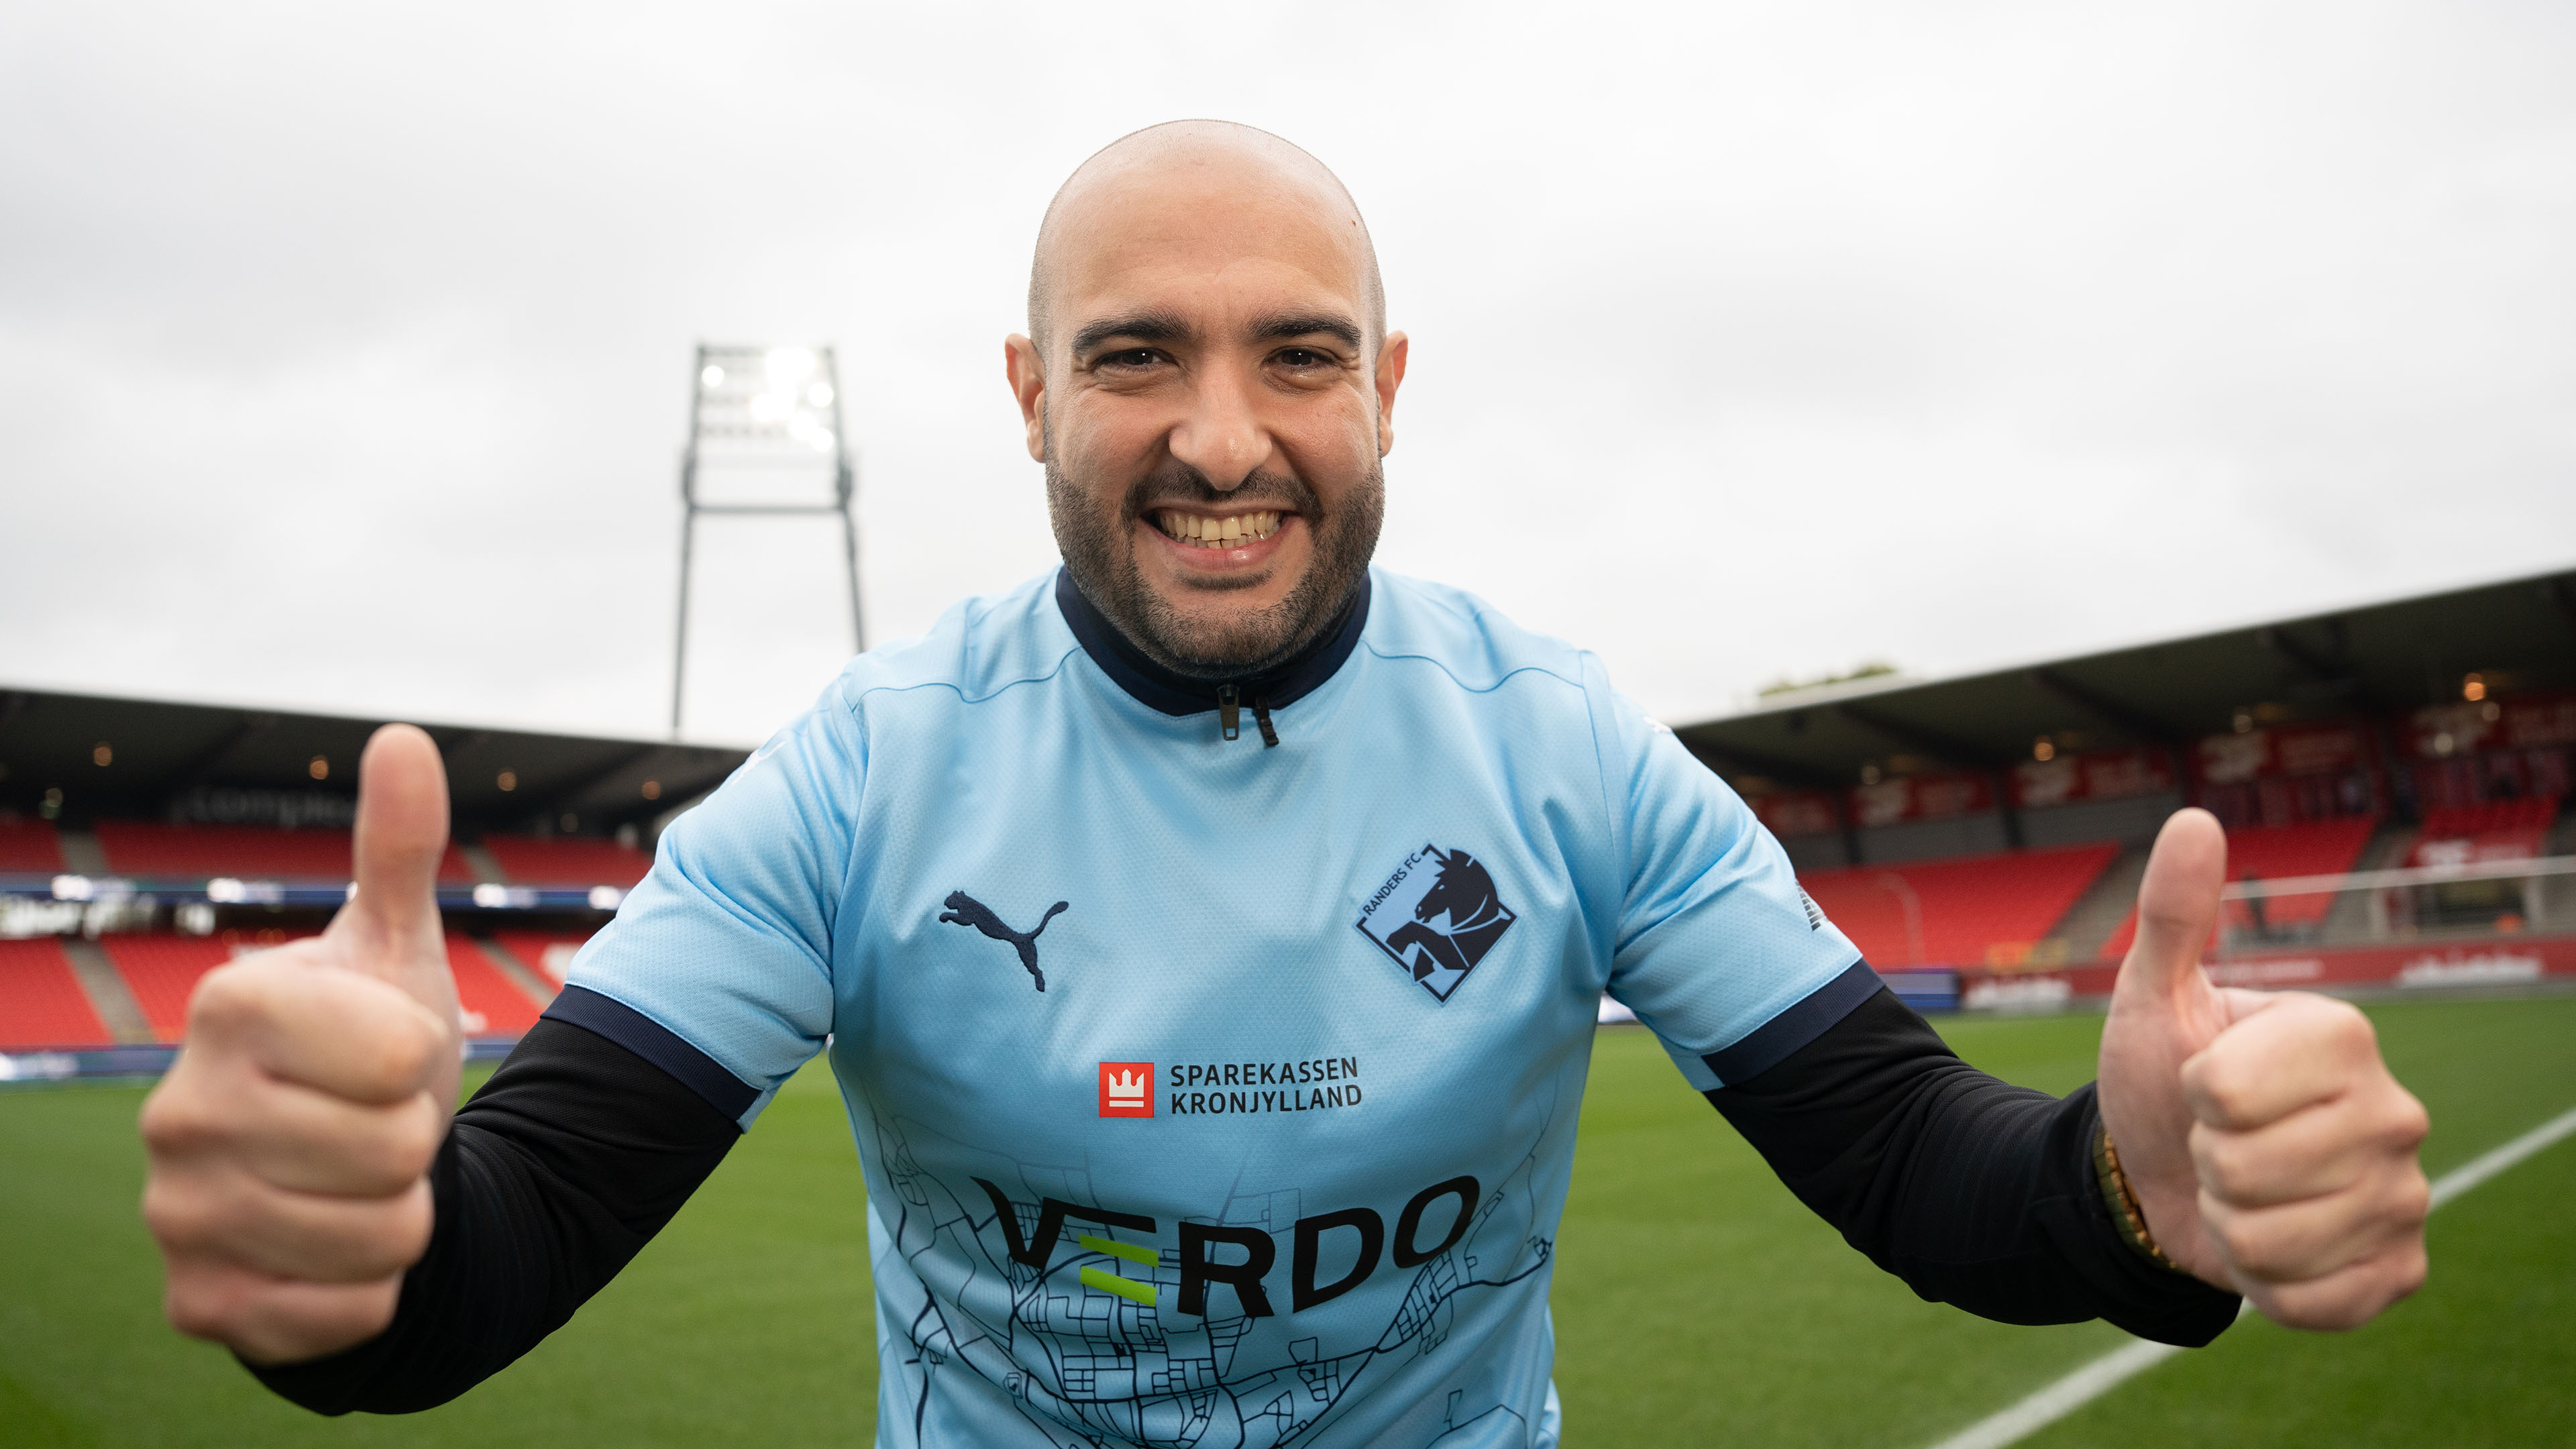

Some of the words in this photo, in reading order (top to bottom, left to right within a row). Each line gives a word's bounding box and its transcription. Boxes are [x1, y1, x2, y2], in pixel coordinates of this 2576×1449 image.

[1362, 868, 1407, 916] RANDERS
[1404, 853, 1421, 870] FC
[1170, 1057, 1358, 1086] SPAREKASSEN
[1171, 1084, 1362, 1114] KRONJYLLAND
[970, 1175, 1481, 1318] VERDO
